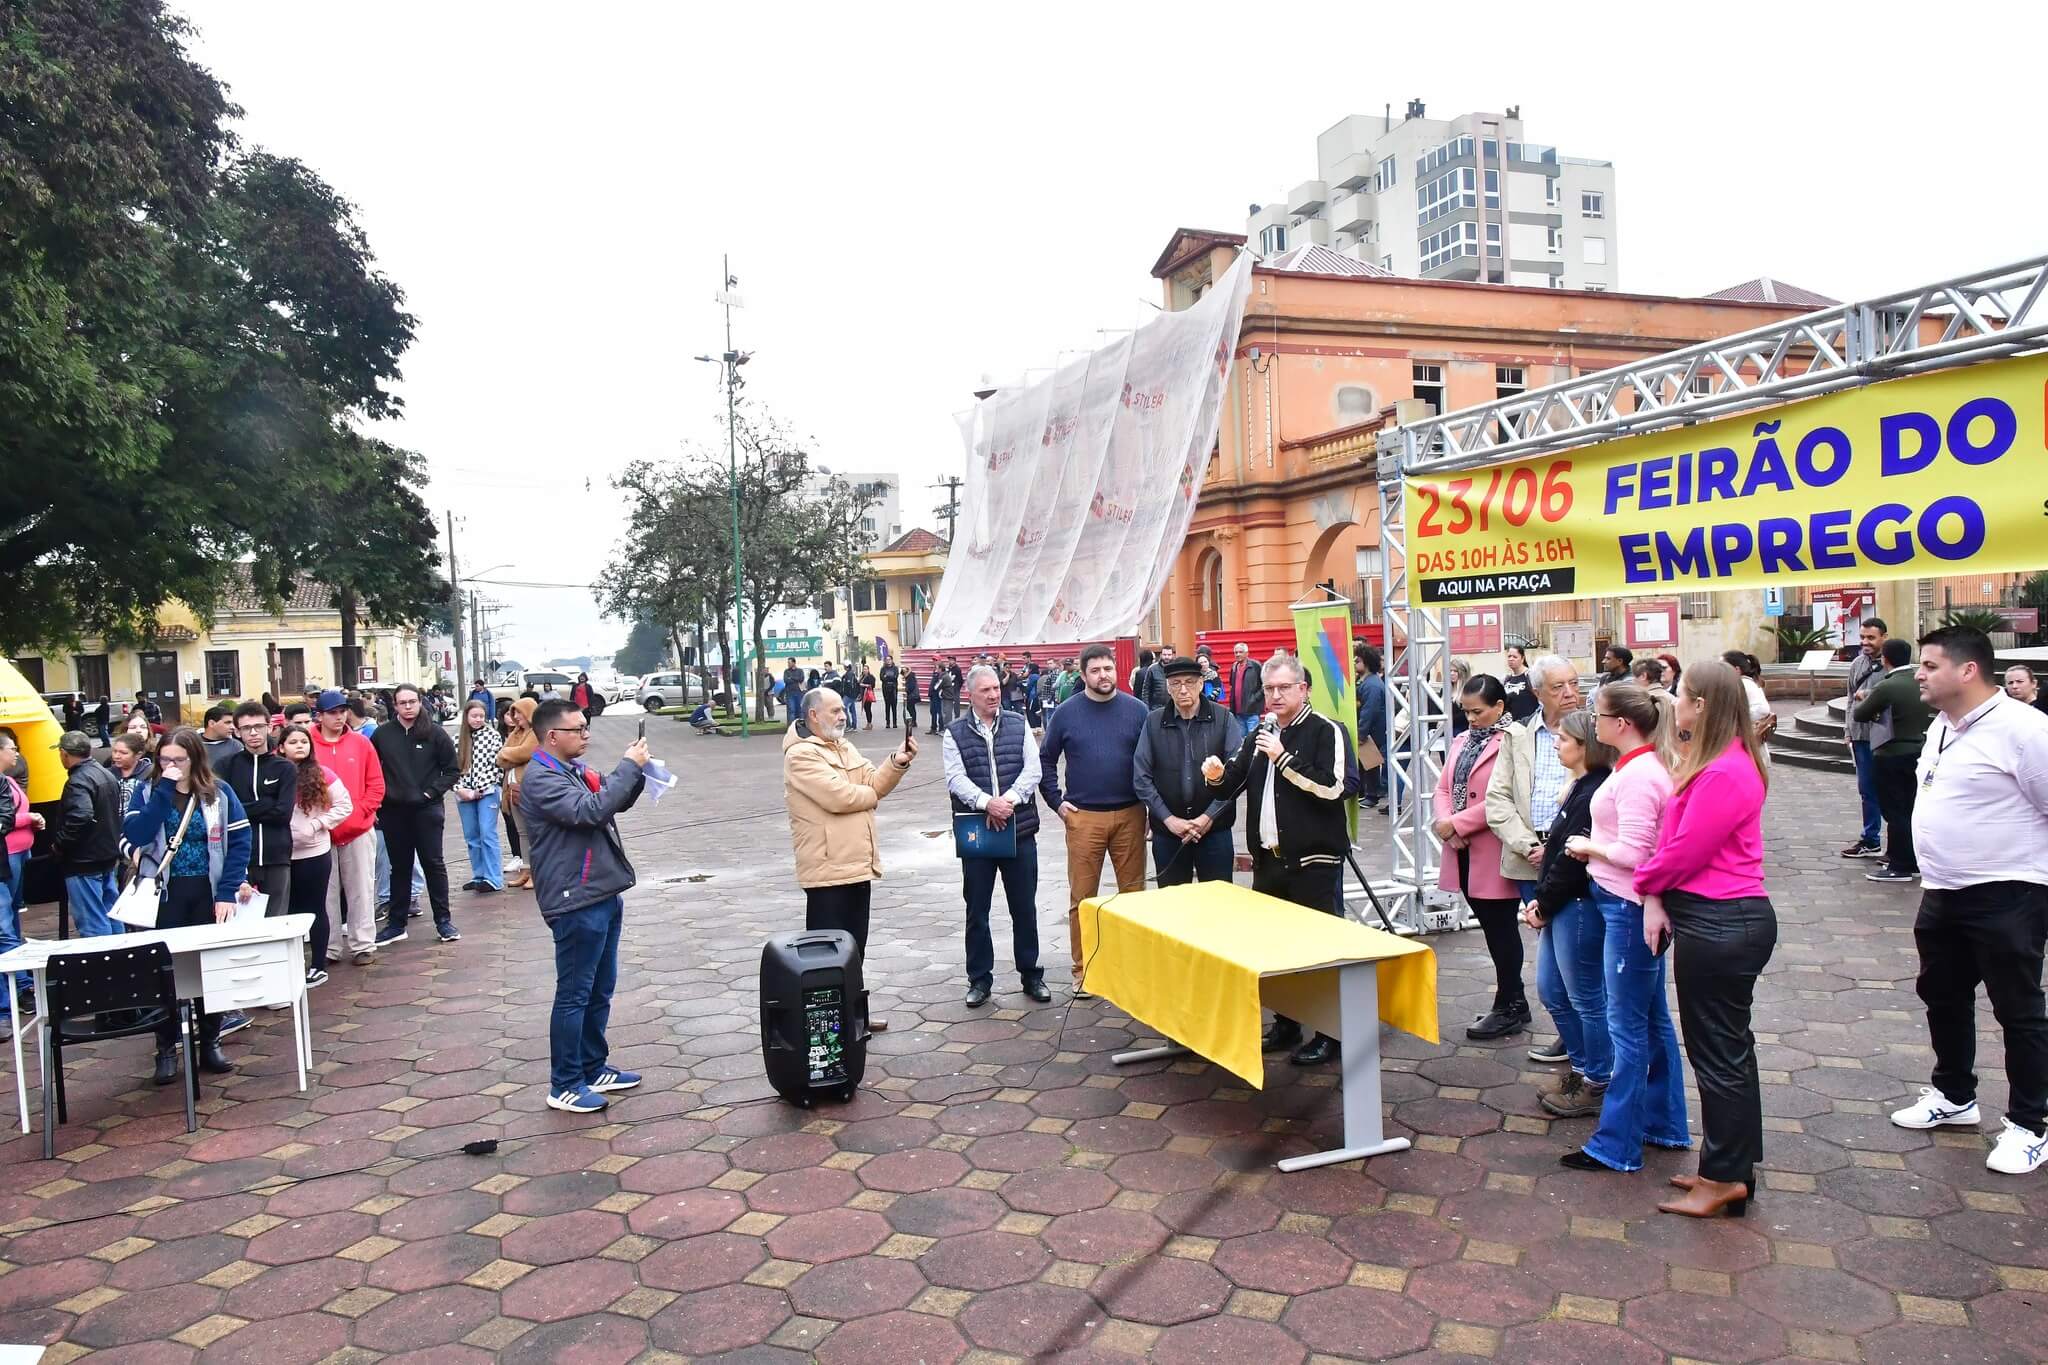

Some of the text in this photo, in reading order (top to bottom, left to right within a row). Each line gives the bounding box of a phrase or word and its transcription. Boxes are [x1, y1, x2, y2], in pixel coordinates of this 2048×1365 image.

[1603, 397, 2018, 515] FEIRÃO DO
[1417, 461, 1574, 538] 23/06
[1416, 537, 1574, 574] DAS 10H ÀS 16H
[1618, 495, 1986, 584] EMPREGO
[1437, 573, 1551, 596] AQUI NA PRAÇA
[776, 641, 810, 650] REABILITA
